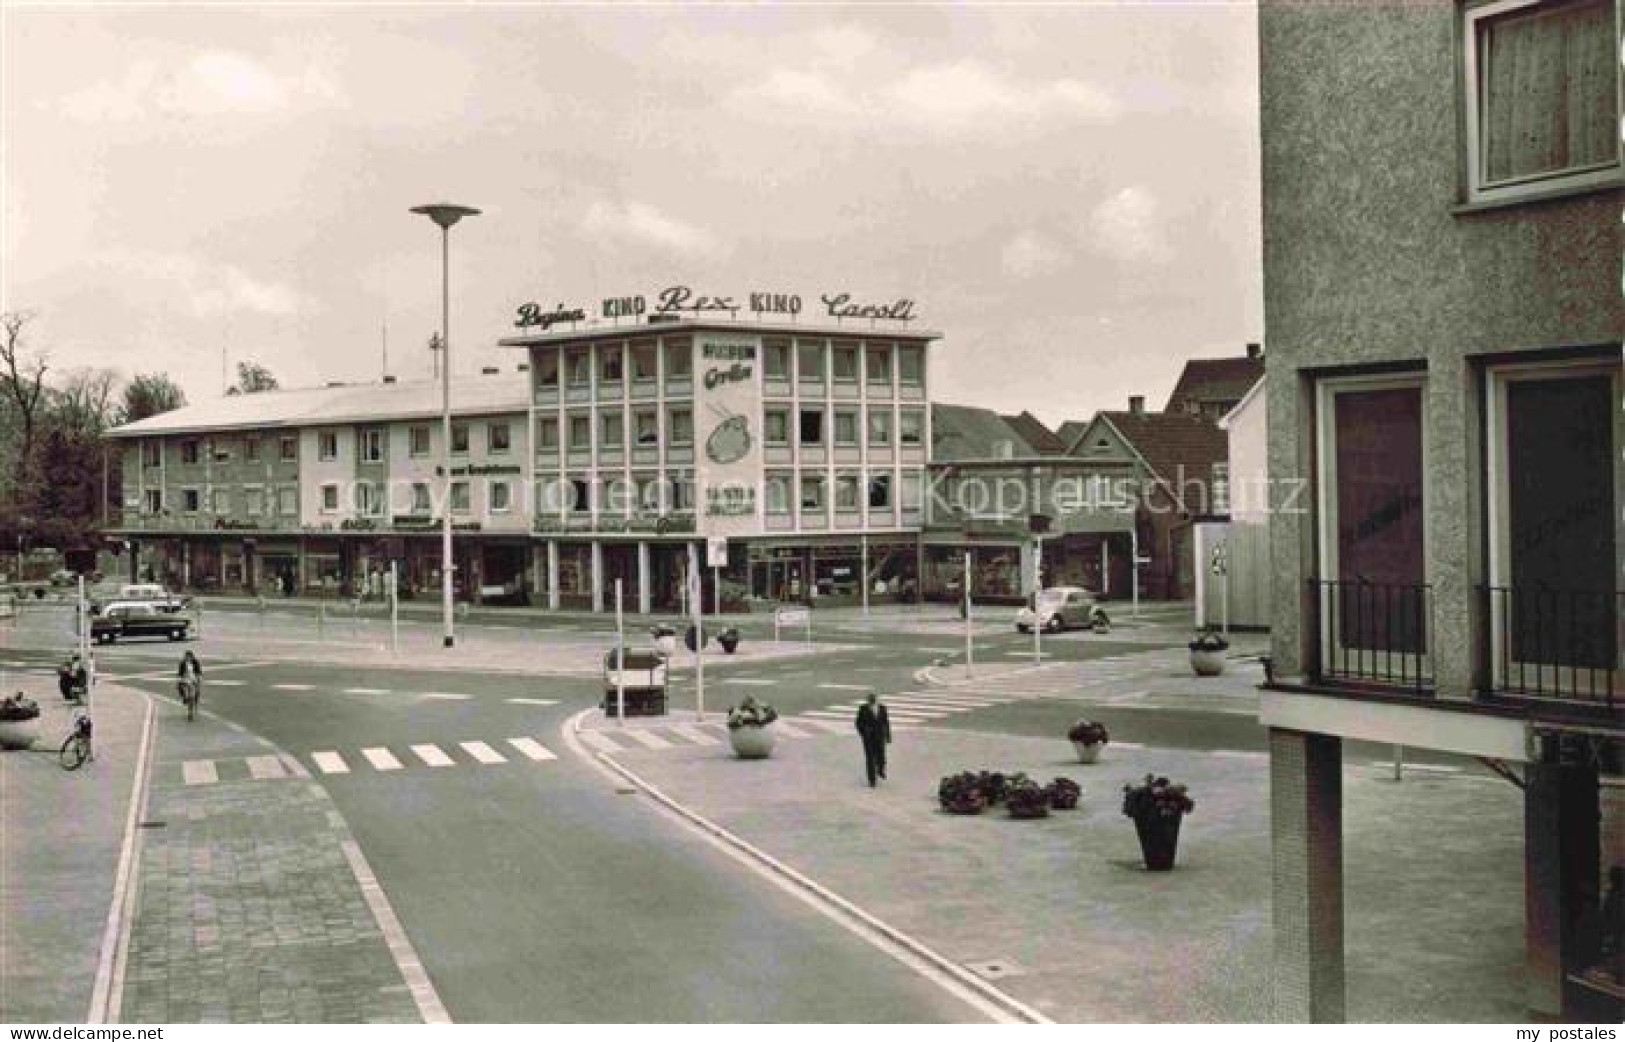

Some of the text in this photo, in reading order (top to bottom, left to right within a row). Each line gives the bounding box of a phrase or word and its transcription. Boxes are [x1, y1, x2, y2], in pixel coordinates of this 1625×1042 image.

[603, 295, 646, 317] KINO
[655, 285, 741, 313] Rex
[750, 292, 802, 314] KINO
